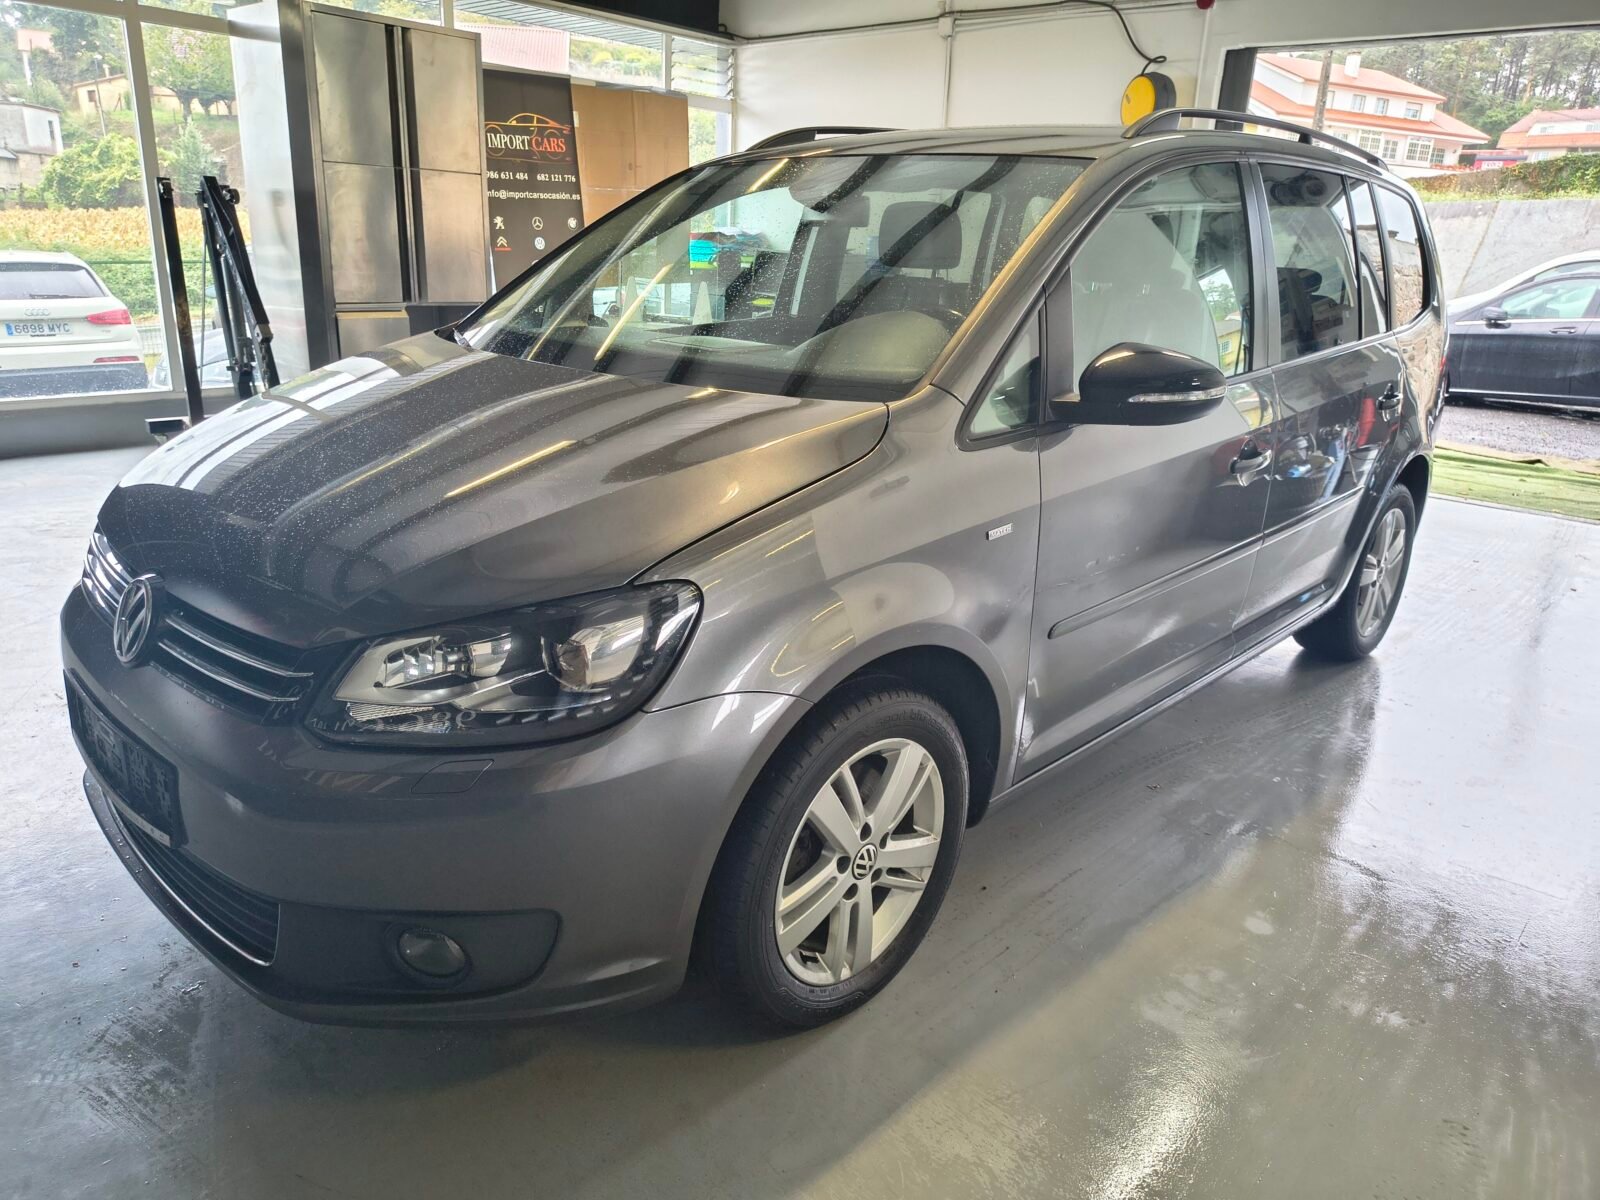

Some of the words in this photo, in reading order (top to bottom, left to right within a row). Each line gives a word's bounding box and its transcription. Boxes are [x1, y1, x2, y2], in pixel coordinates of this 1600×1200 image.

[487, 133, 530, 150] IMPORT
[532, 136, 566, 153] CARS
[501, 172, 514, 180] 631
[516, 172, 528, 180] 484
[551, 174, 562, 182] 121
[564, 175, 576, 183] 776
[487, 189, 581, 200] nfo@importcarsocasión.es
[48, 322, 70, 333] MYC
